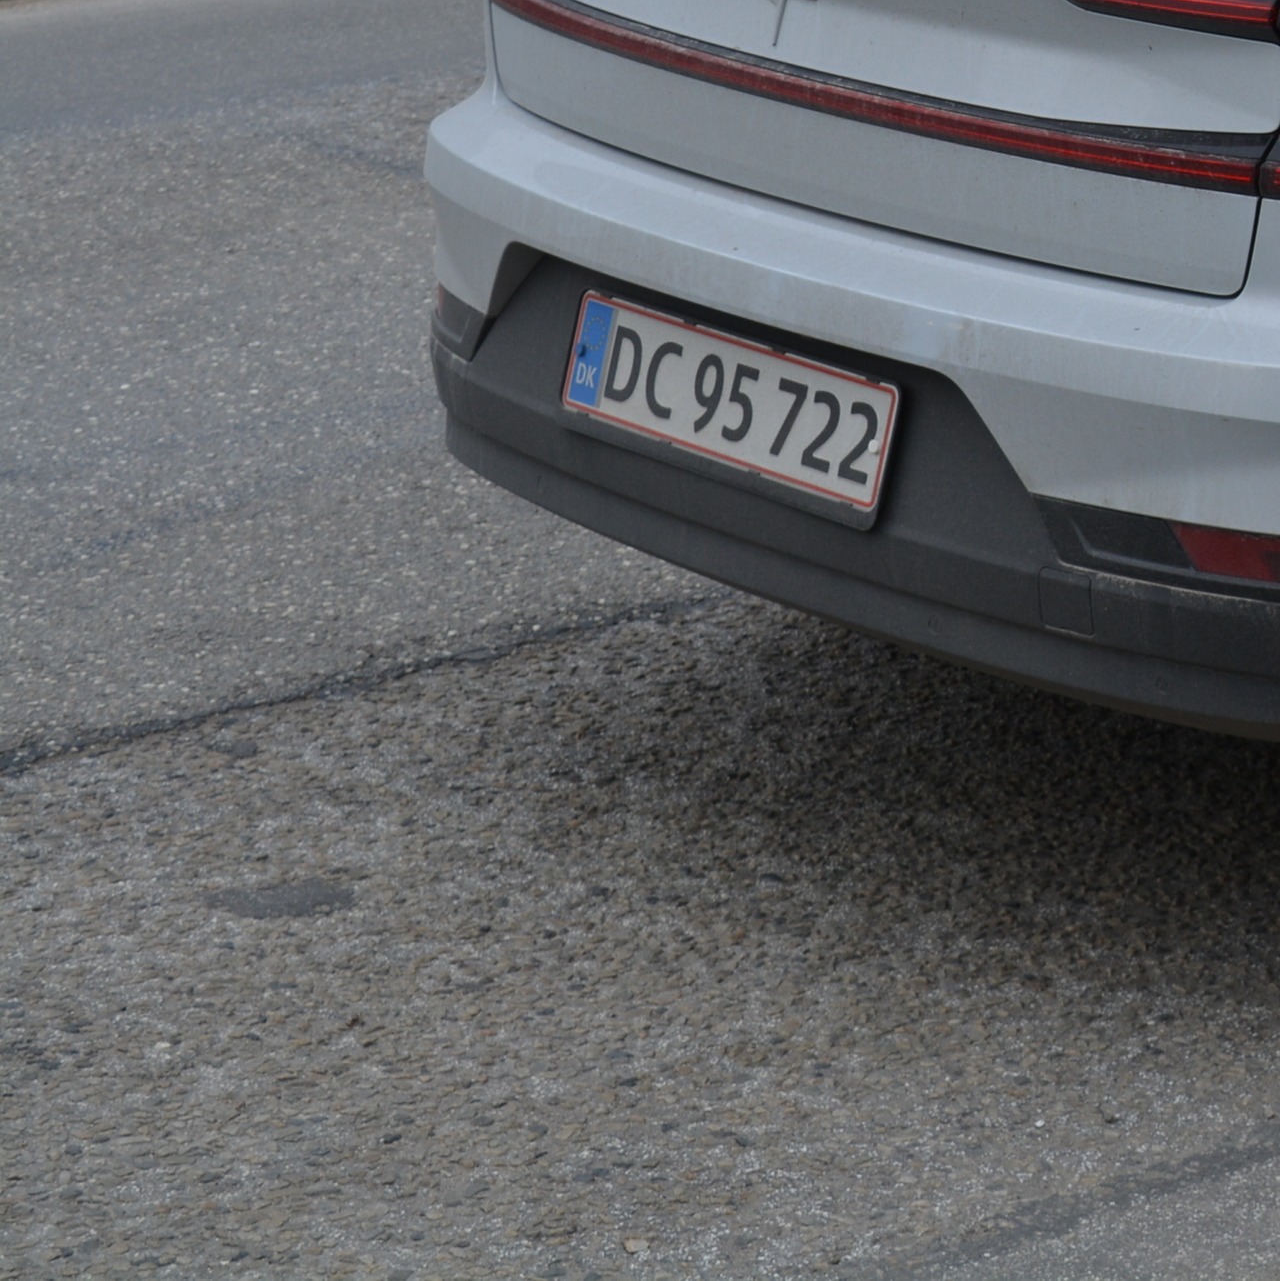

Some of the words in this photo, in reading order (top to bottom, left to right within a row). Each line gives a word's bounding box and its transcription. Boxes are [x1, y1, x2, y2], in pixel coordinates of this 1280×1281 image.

[575, 362, 600, 390] DK
[603, 323, 685, 421] DC
[693, 353, 761, 444] 95
[769, 376, 880, 486] 722
